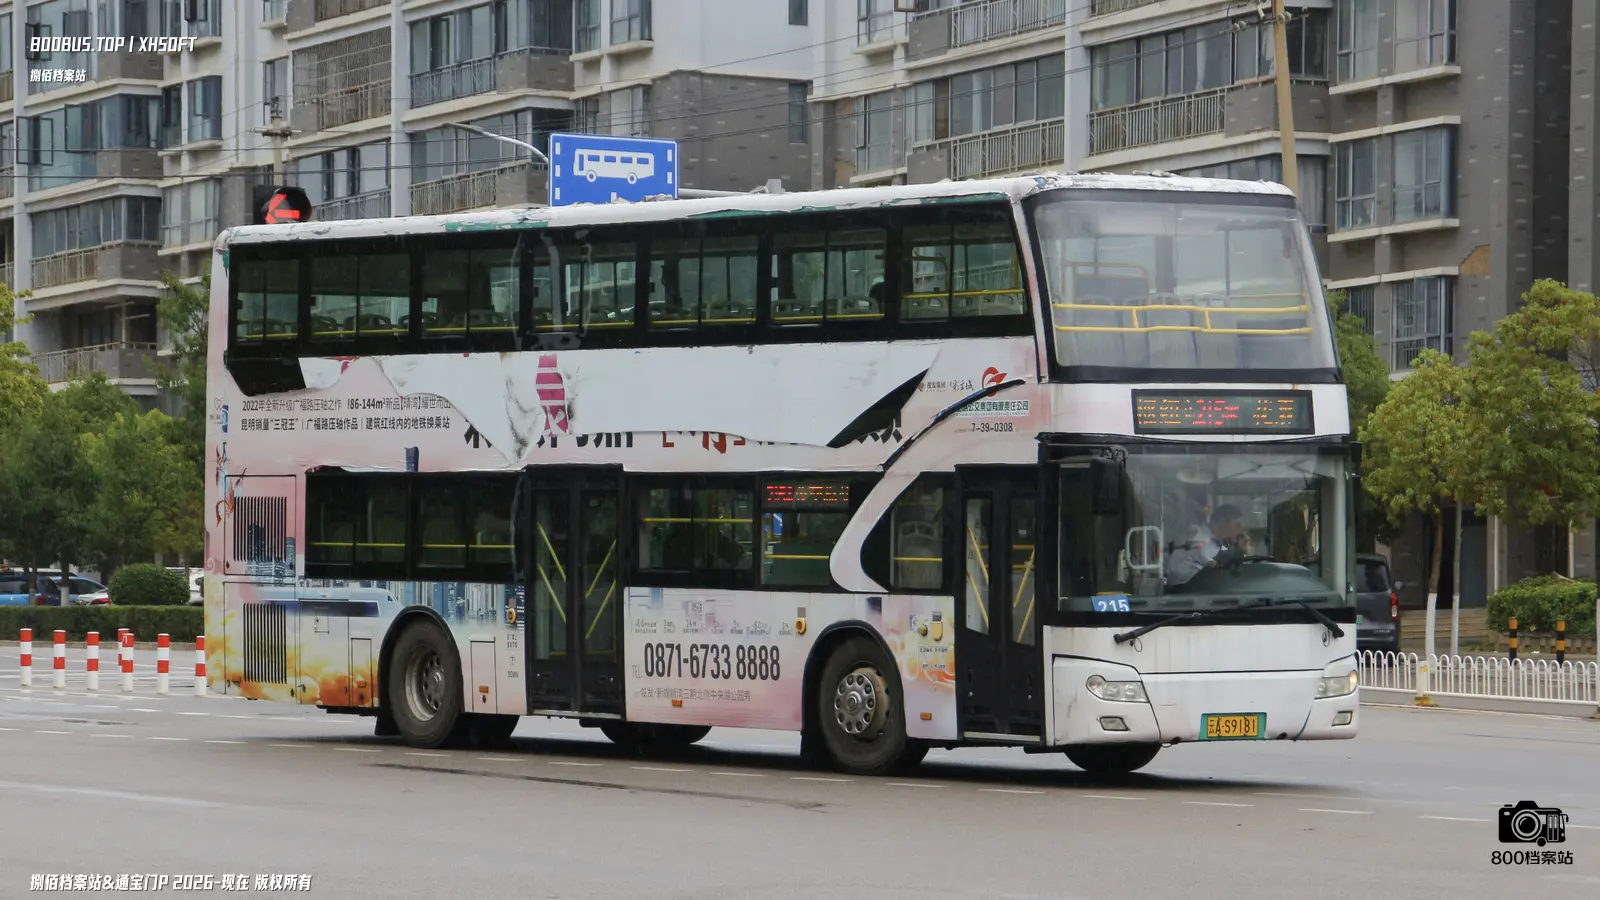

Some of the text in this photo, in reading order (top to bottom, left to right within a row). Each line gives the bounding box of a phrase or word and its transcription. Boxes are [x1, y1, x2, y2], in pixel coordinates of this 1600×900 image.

[958, 400, 1029, 412] 公交集团有限责任公司
[306, 417, 358, 431] 广福路压轴作品
[365, 416, 450, 430] 建筑红线内的地铁换乘站
[1098, 599, 1130, 612] 215
[644, 642, 731, 679] 0871-6733
[736, 644, 781, 681] 8888
